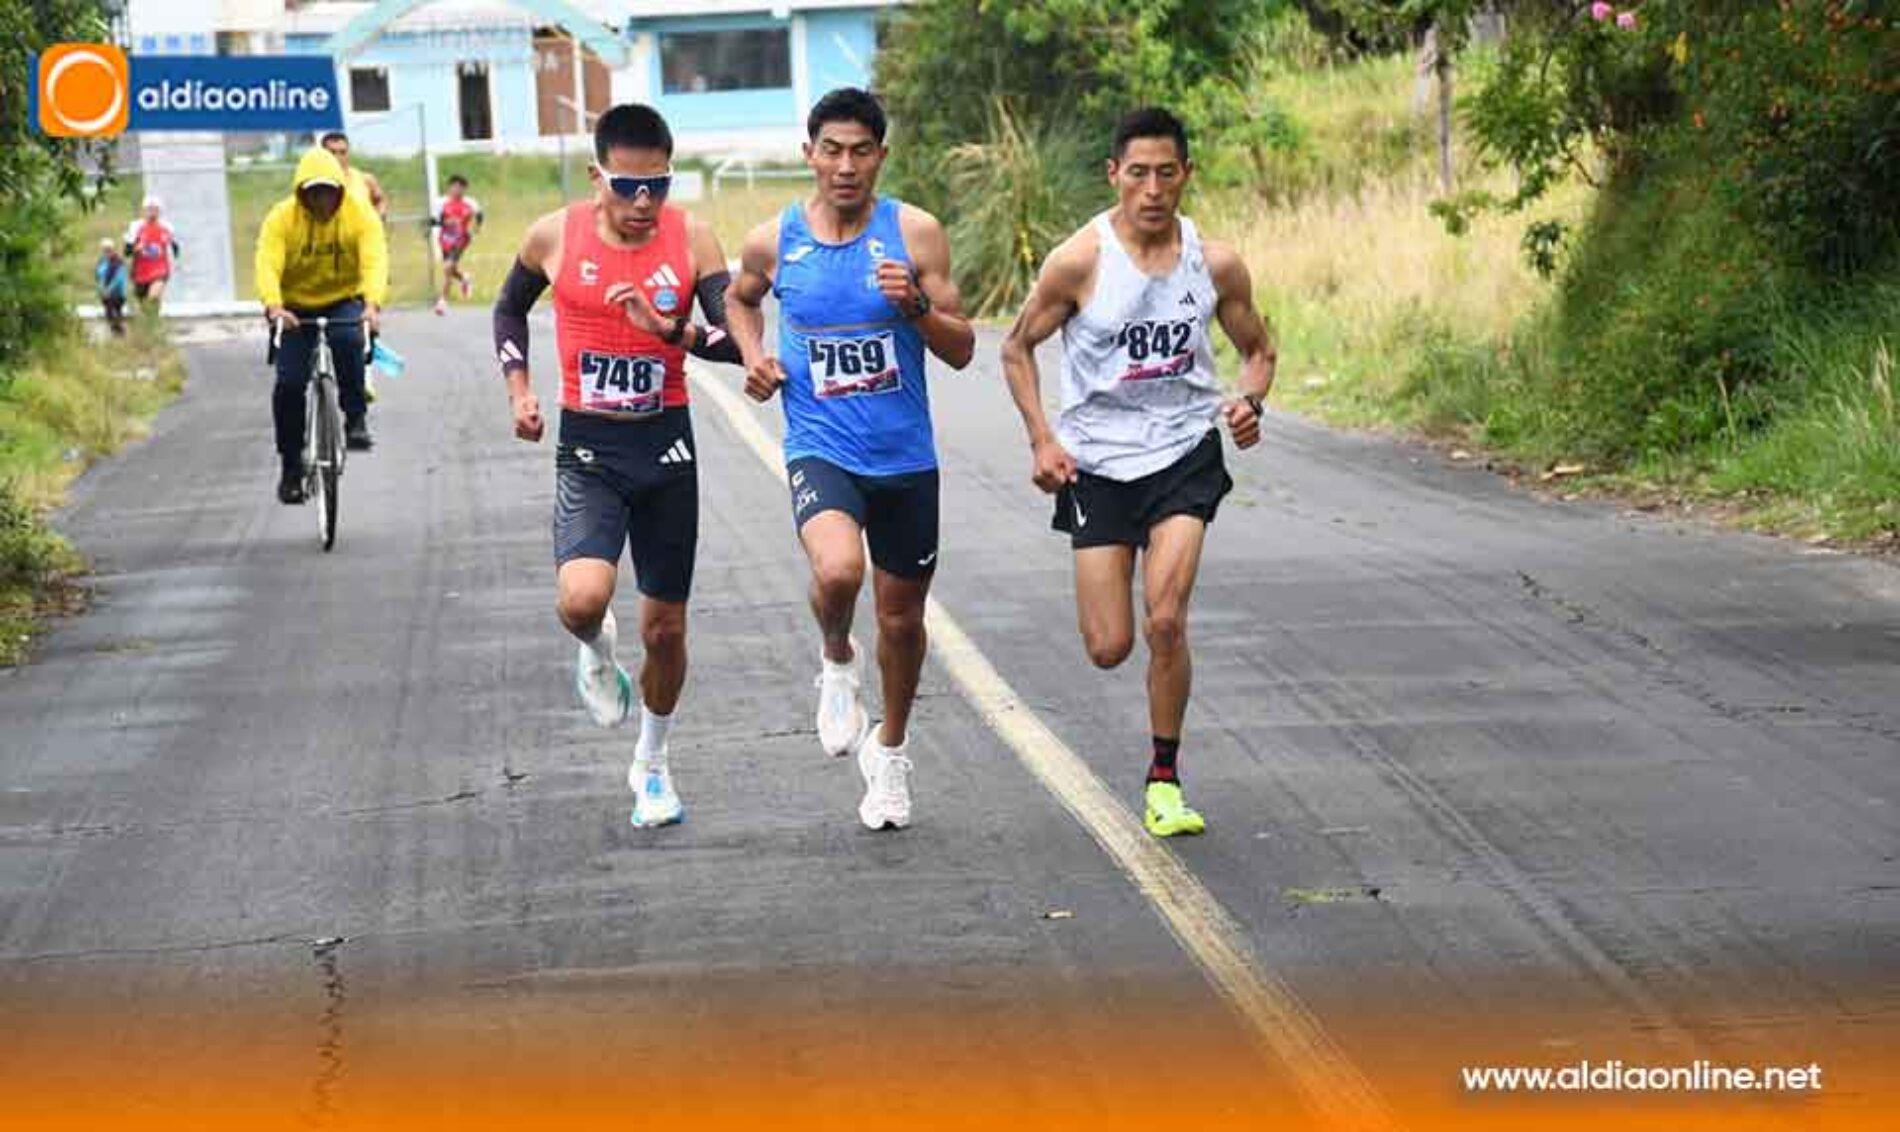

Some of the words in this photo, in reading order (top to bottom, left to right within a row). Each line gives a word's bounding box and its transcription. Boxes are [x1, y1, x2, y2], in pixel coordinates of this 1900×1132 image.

[819, 339, 886, 376] 769
[1128, 322, 1191, 360] 842
[592, 357, 652, 393] 748
